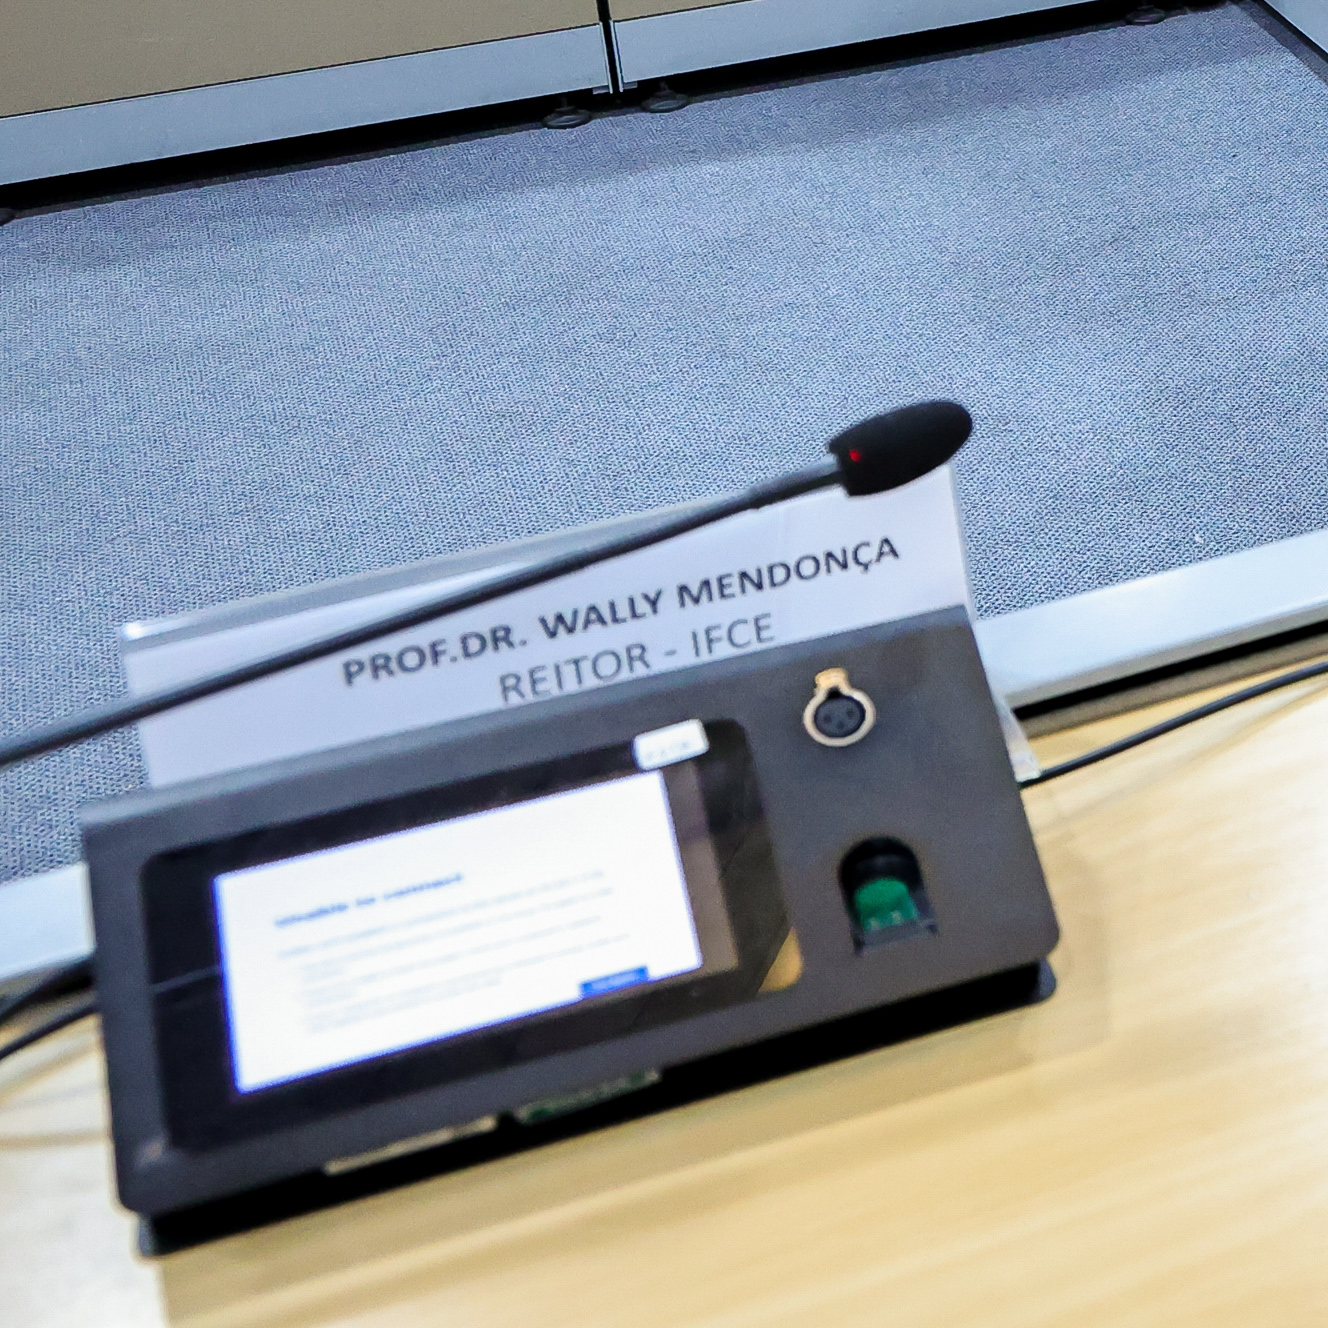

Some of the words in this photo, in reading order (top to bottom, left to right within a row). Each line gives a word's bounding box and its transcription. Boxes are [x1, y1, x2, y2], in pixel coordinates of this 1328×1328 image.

[342, 623, 528, 687] PROF.DR.
[538, 588, 665, 641] WALLY
[678, 536, 901, 610] MENDONÇA
[499, 643, 654, 705] REITOR
[692, 613, 776, 660] IFCE
